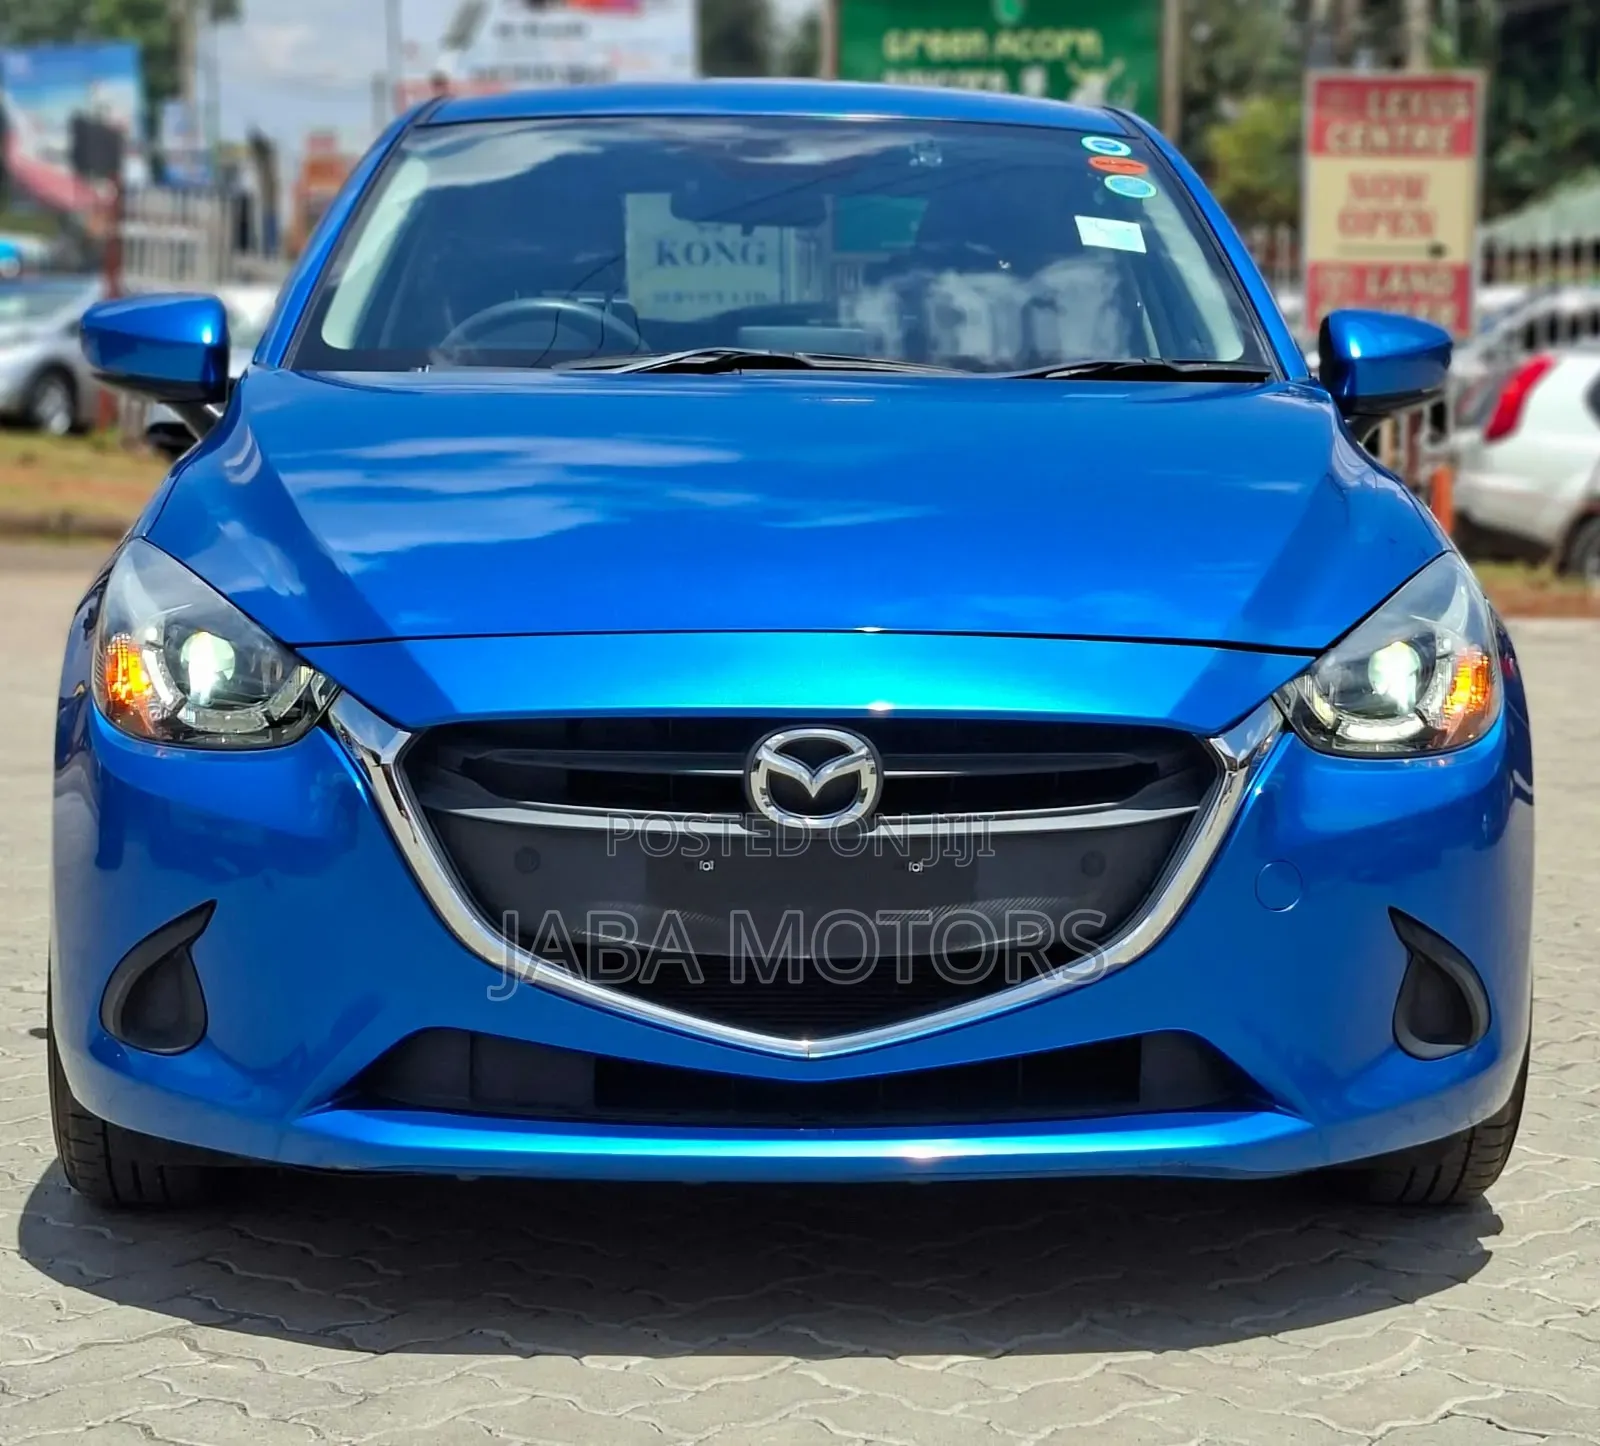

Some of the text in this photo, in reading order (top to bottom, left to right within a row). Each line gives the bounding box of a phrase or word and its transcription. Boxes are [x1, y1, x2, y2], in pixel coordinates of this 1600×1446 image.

[1326, 122, 1449, 150] CENTRE
[1348, 172, 1428, 200] NOW
[1337, 210, 1436, 238] OPEN
[655, 240, 767, 267] KONG
[1366, 267, 1454, 296] LAND
